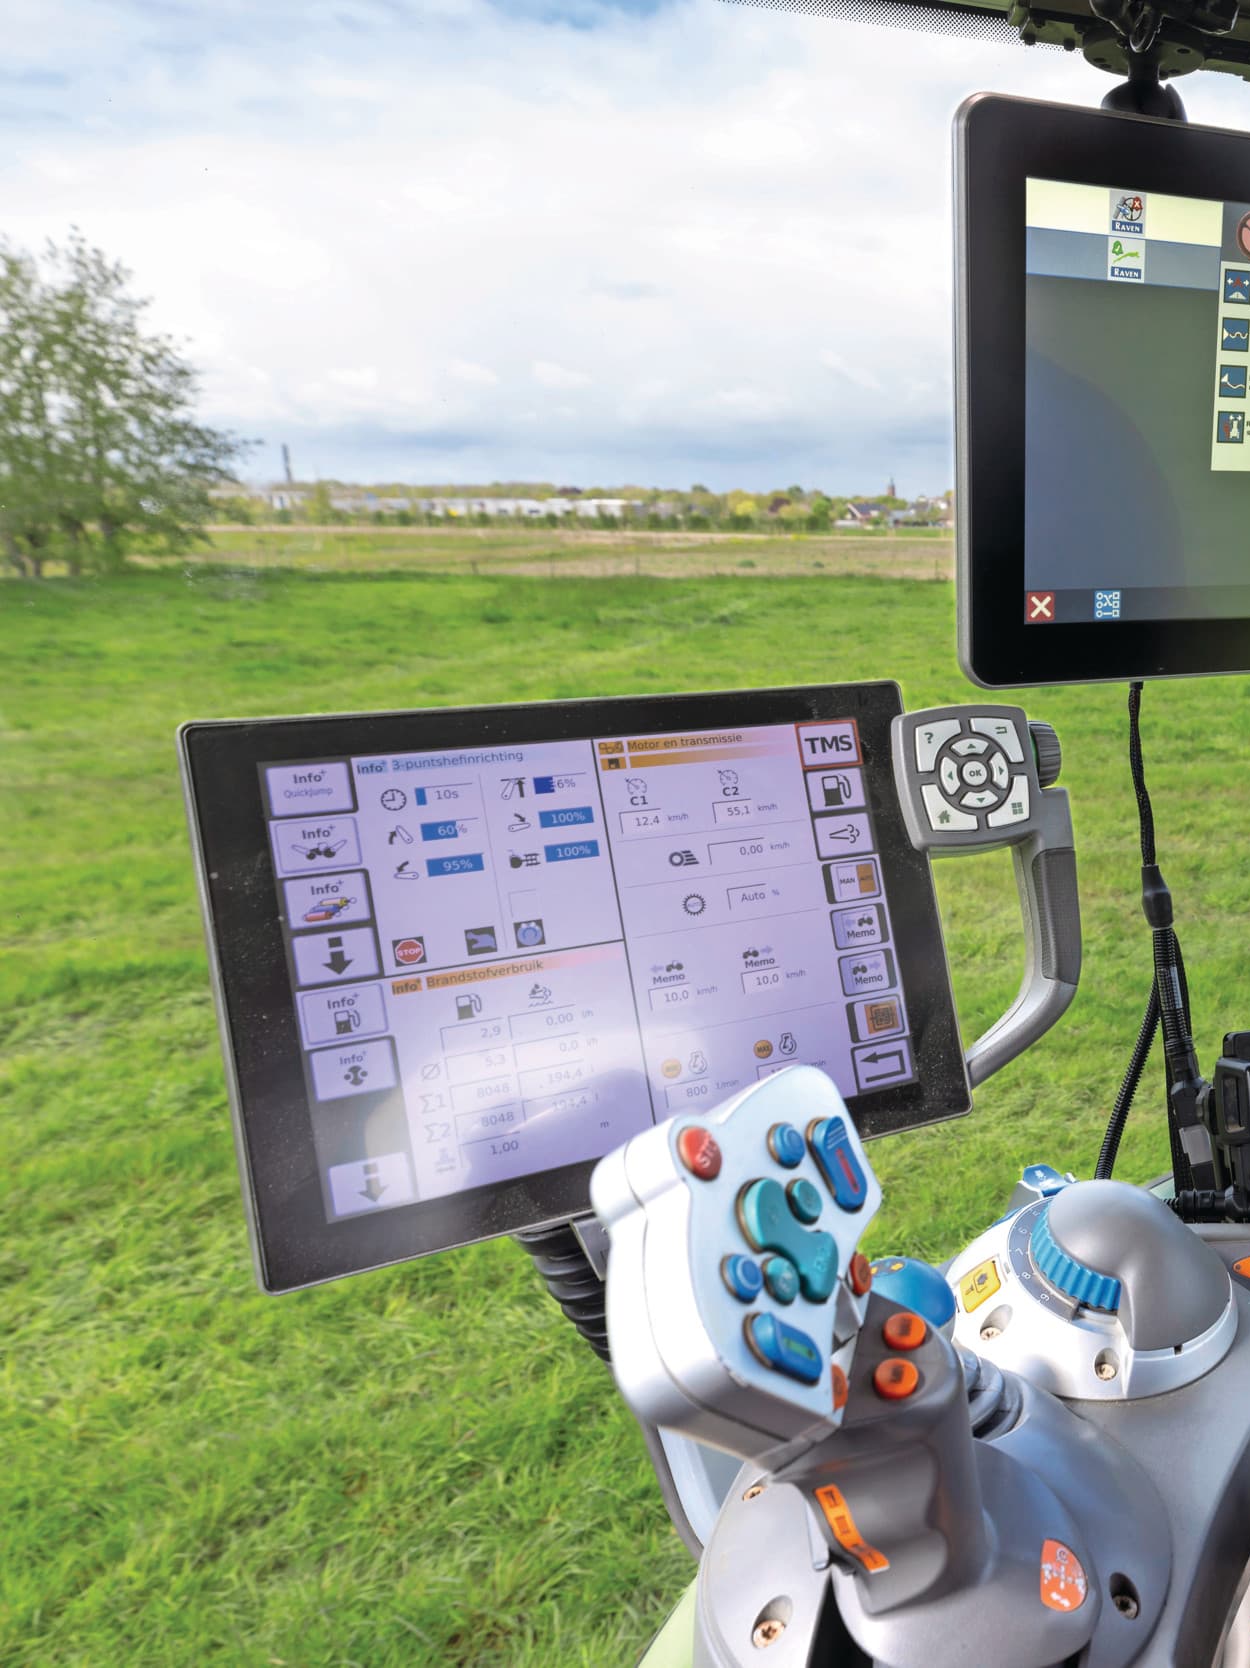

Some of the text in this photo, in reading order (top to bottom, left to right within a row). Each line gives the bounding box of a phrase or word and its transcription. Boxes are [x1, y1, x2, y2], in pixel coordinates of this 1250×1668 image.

[1114, 221, 1141, 233] RAVEN
[1113, 267, 1140, 279] RAVEN
[627, 733, 743, 752] Motor en transmissie
[804, 734, 853, 755] TMS
[391, 750, 524, 771] 3-puntshefinrichting
[436, 789, 459, 800] 10s
[722, 786, 740, 797] C2
[630, 795, 649, 806] C1
[551, 812, 586, 824] 100%
[726, 805, 751, 818] 55,1
[438, 824, 468, 836] 60%
[555, 845, 592, 858] 100%
[442, 858, 473, 871] 95%
[740, 890, 766, 903] Auto
[846, 928, 876, 940] Memo
[396, 946, 421, 957] STOP
[744, 956, 776, 969] Memo
[426, 960, 544, 988] Brandstofverbruik
[652, 972, 686, 985] Memo
[854, 973, 884, 985] Memo
[686, 1084, 708, 1098] 800
